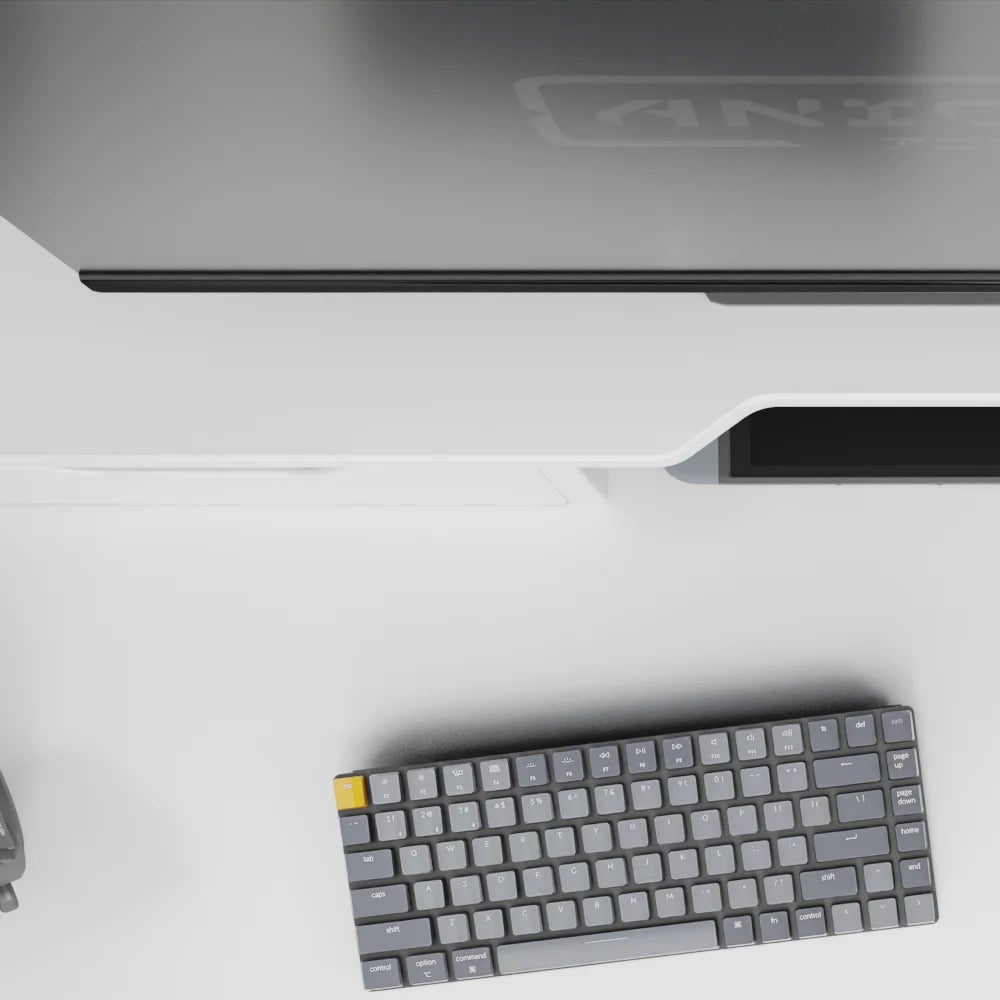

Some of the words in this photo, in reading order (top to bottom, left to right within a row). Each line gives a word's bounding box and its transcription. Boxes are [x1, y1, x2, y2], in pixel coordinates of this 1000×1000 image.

[855, 720, 866, 729] del
[893, 752, 909, 761] page
[896, 789, 912, 798] page
[897, 797, 916, 805] down
[908, 862, 921, 871] end
[821, 873, 836, 881] shift
[799, 911, 822, 921] control
[386, 926, 401, 934] shift
[455, 952, 487, 963] command
[369, 963, 392, 973] control
[415, 959, 437, 968] option
